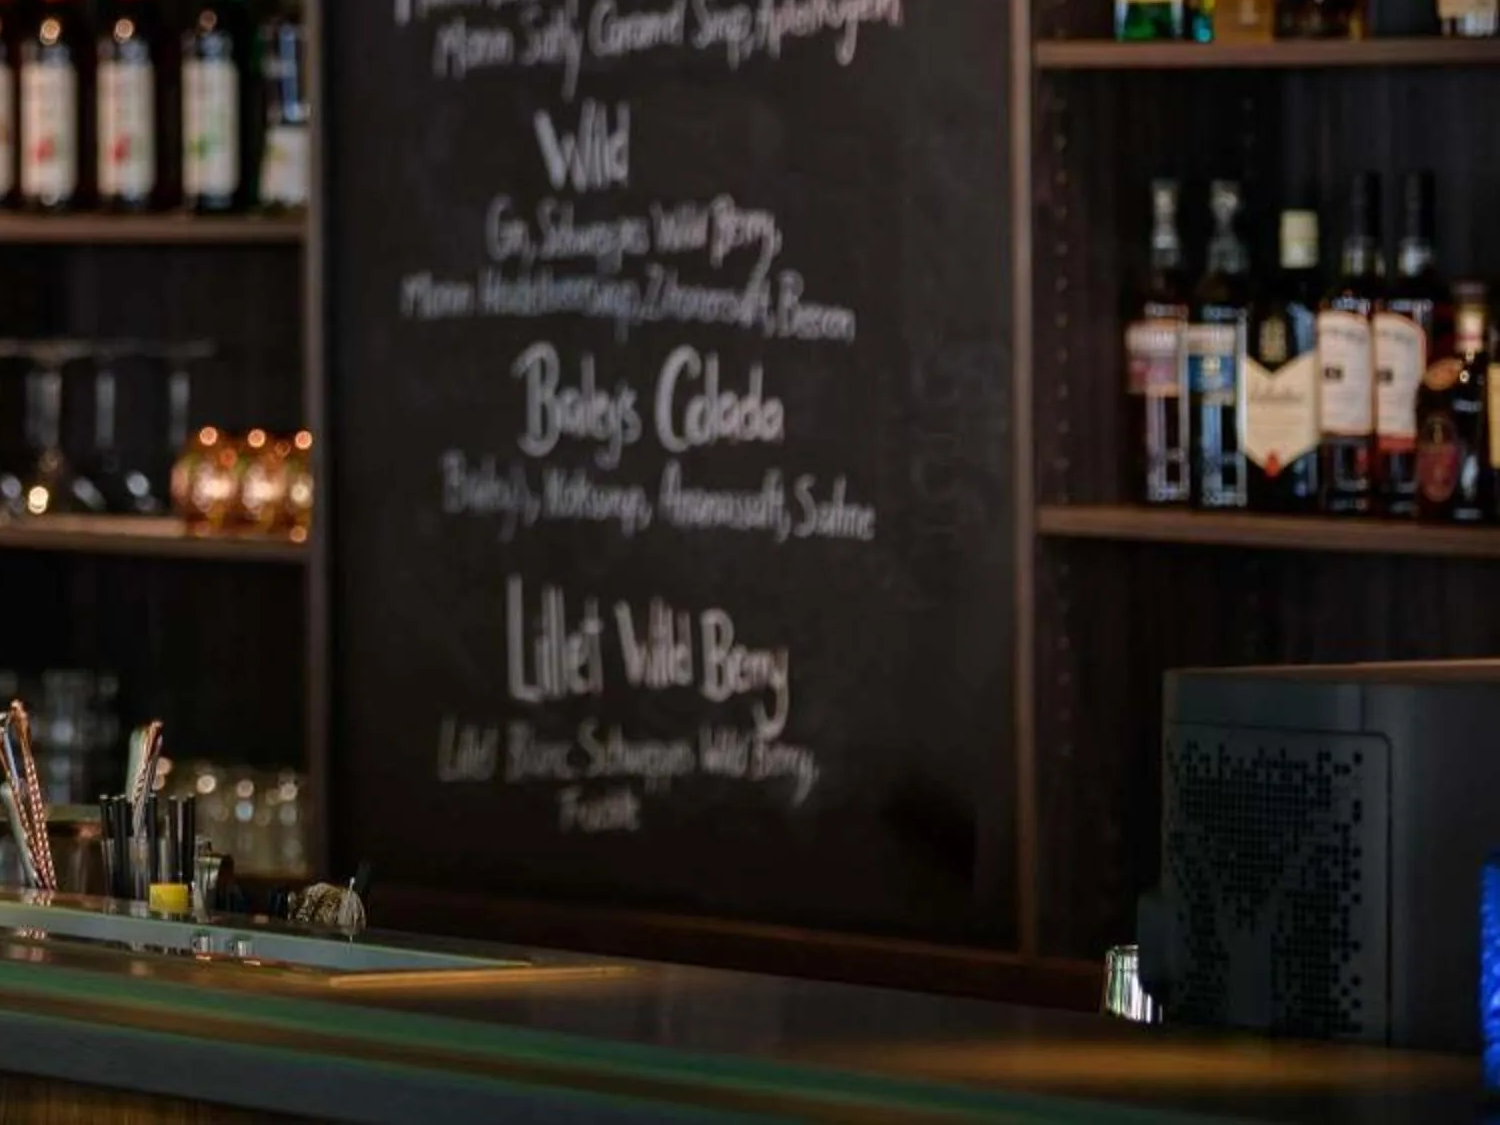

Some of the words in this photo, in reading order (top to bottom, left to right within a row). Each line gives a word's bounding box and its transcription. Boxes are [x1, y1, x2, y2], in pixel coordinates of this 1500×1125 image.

[533, 97, 633, 193] Wild
[653, 342, 786, 453] Colada
[612, 594, 694, 690] Wild
[698, 606, 792, 739] Berry
